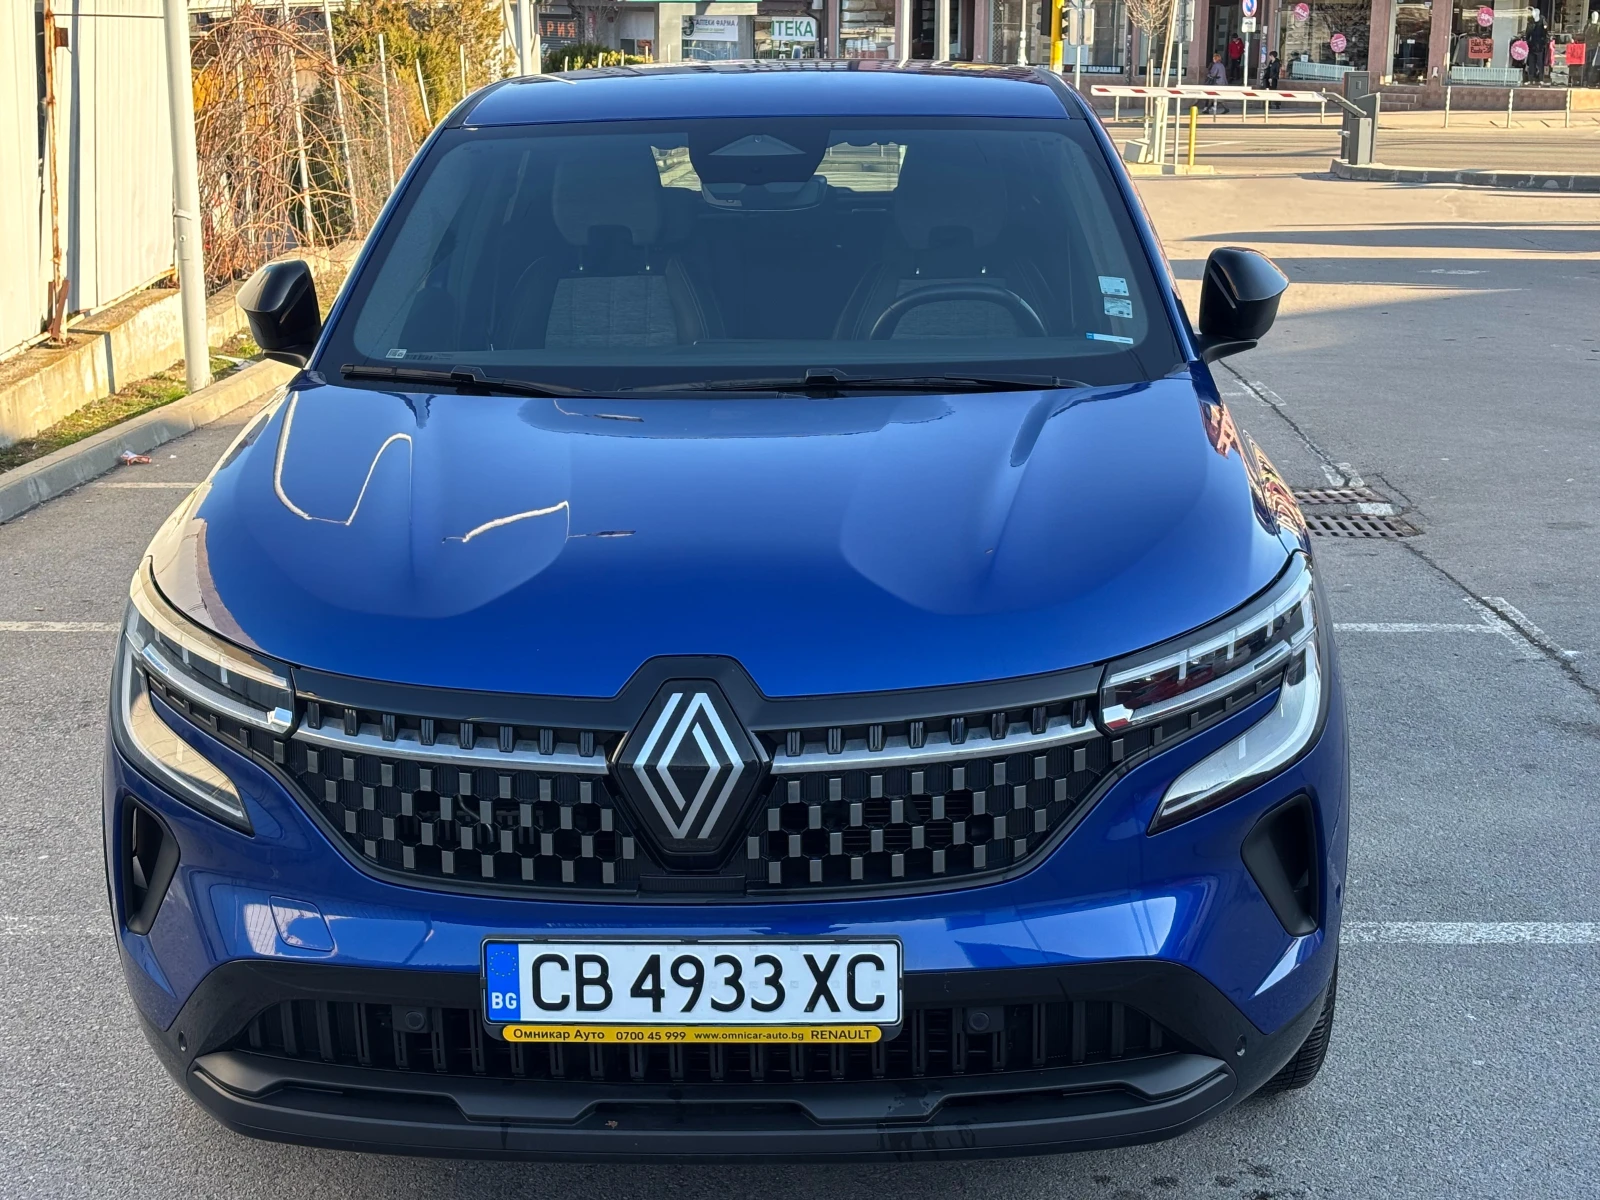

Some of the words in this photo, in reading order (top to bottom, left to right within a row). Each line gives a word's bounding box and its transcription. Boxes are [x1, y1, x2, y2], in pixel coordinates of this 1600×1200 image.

[531, 953, 613, 1011] CB
[630, 954, 786, 1012] 4933
[803, 953, 885, 1012] XC
[491, 992, 517, 1009] BG
[513, 1028, 570, 1041] Омникар
[574, 1029, 605, 1041] Ауто
[616, 1031, 644, 1040] 0700
[647, 1031, 662, 1040] 45
[665, 1031, 687, 1041] 999
[694, 1031, 804, 1041] www.omnicar-auto.bg
[811, 1029, 872, 1040] RENAULT
